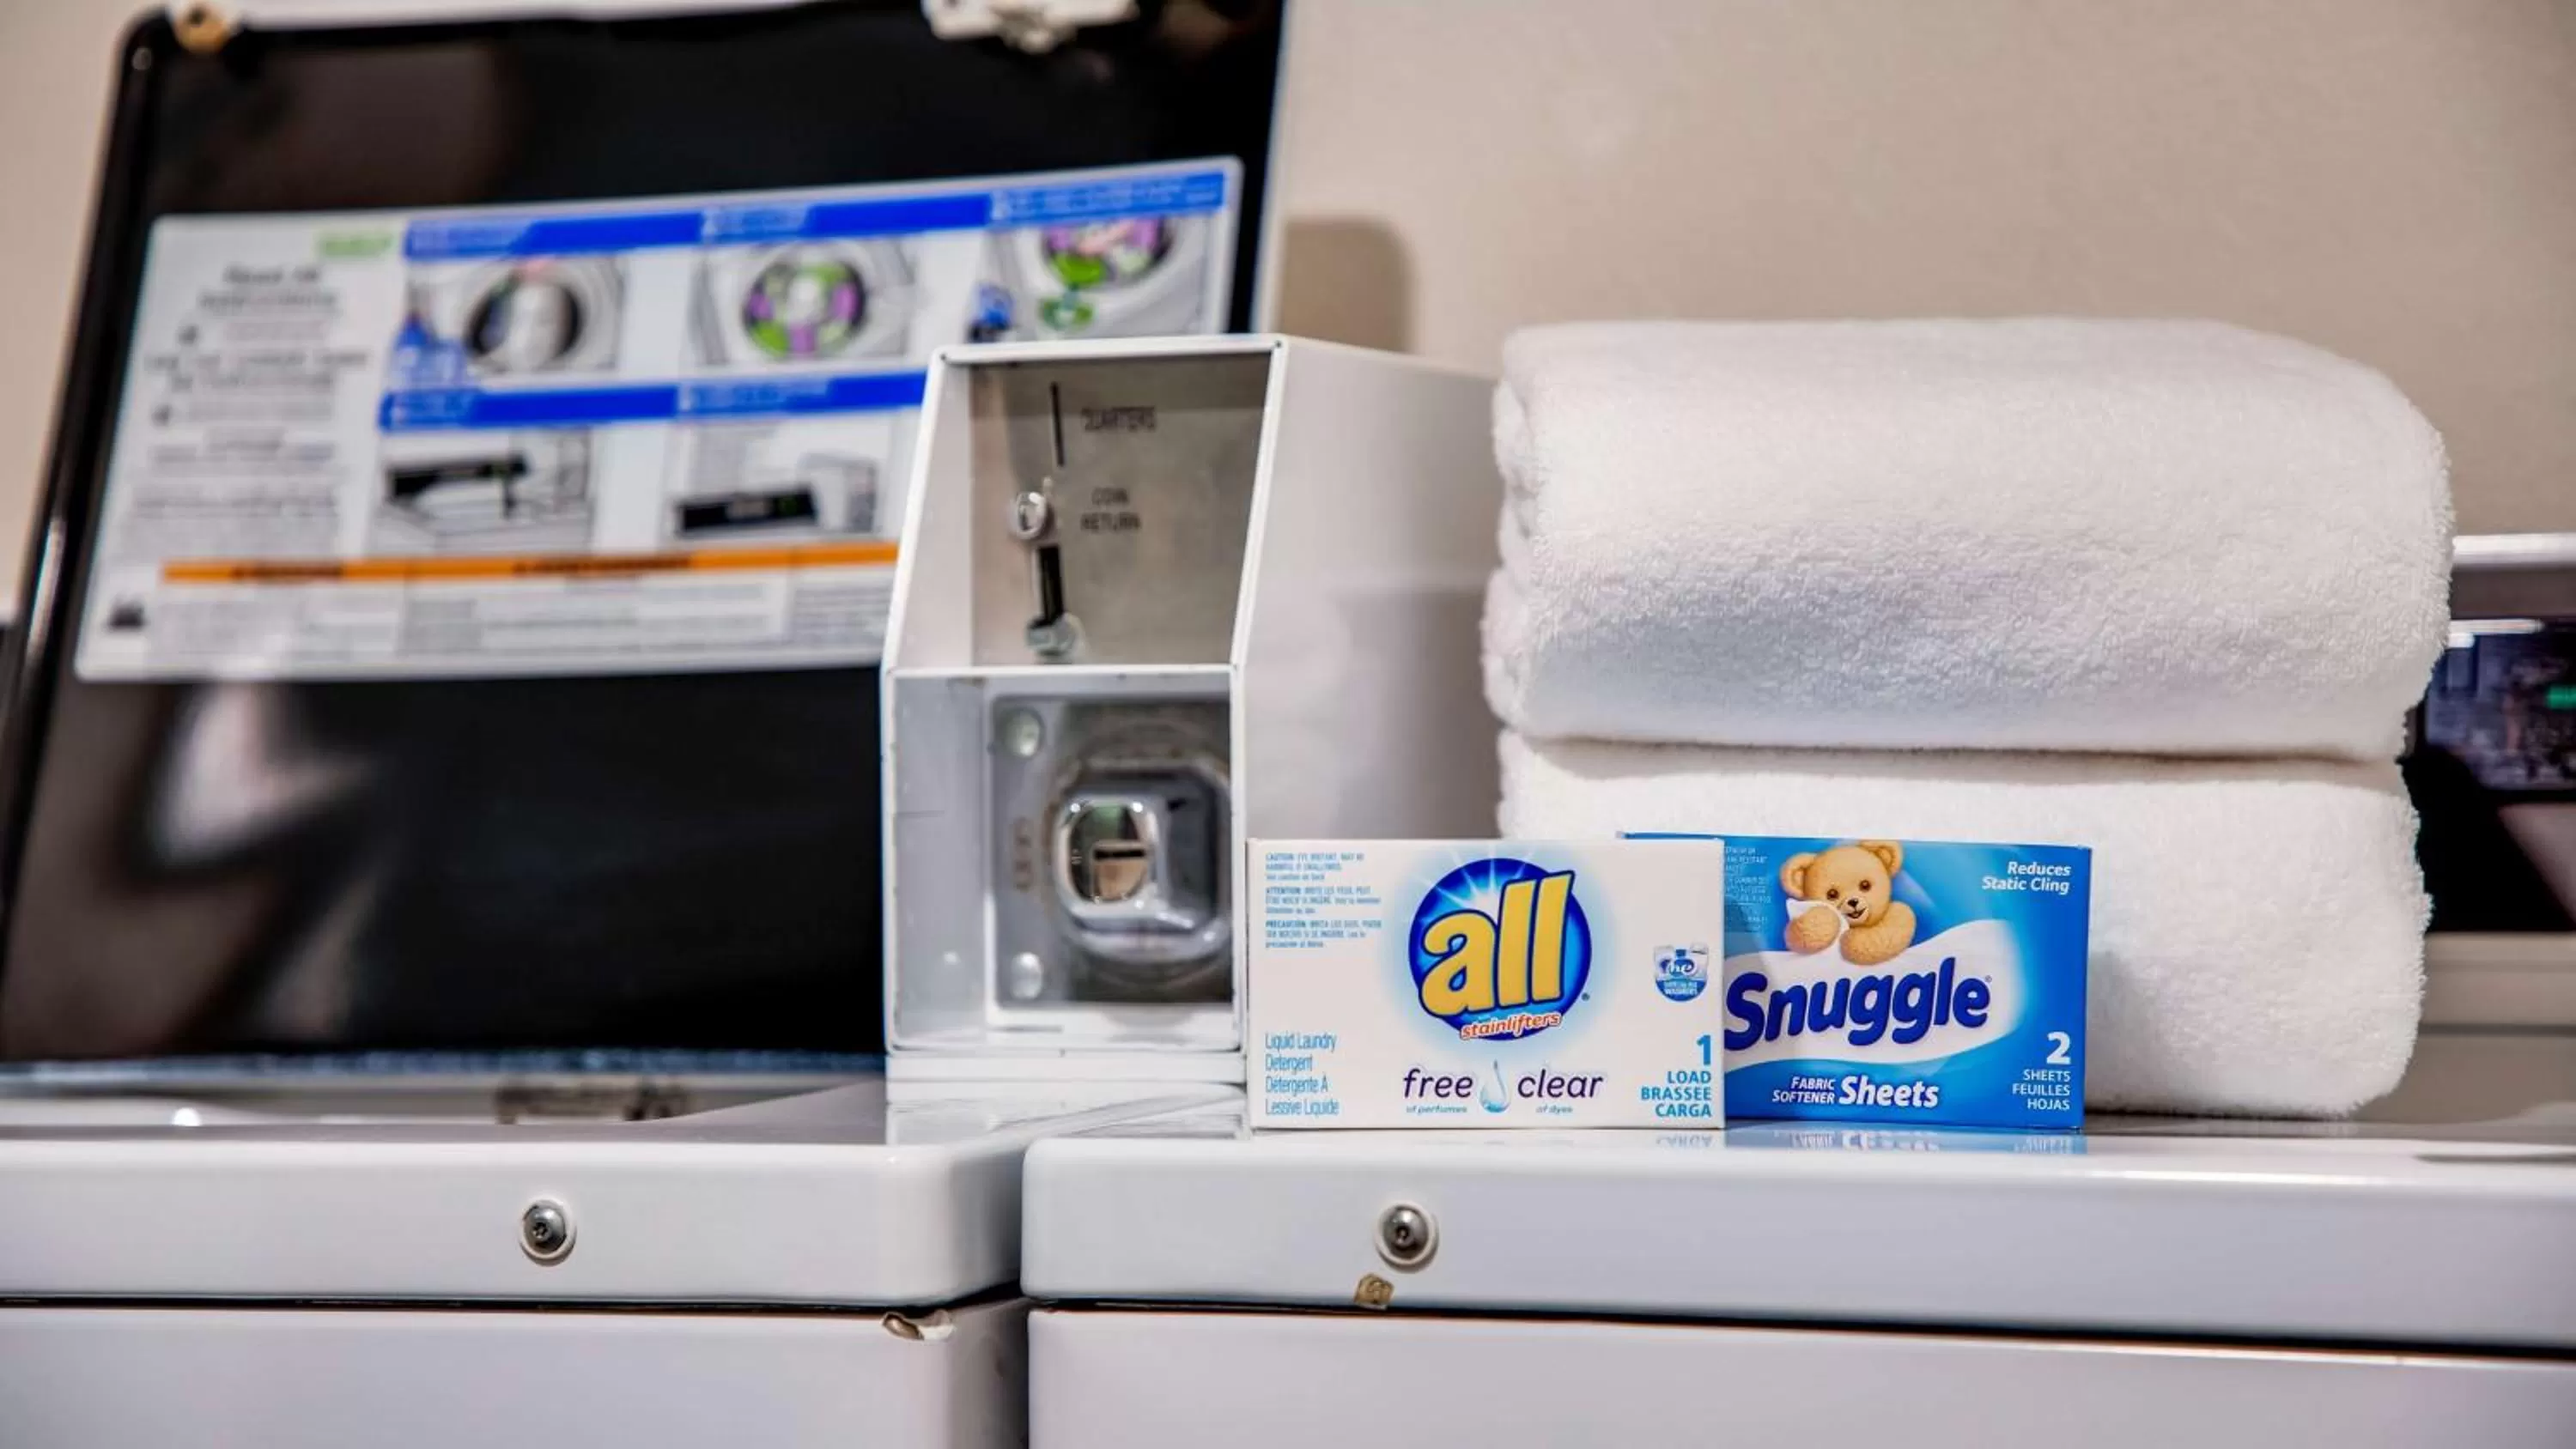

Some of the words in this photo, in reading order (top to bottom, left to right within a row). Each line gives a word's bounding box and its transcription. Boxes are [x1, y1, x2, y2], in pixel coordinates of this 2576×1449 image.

[2008, 861, 2072, 876] Reduces
[1982, 876, 2026, 890] Static
[2031, 876, 2070, 895] Cling
[1419, 870, 1575, 1019] all
[1724, 956, 1991, 1051] Snuggle
[1461, 1012, 1561, 1040] stainlifters
[1265, 1032, 1295, 1052] Liquid
[1297, 1032, 1337, 1053] Laundry
[1697, 1034, 1711, 1065] 1
[2046, 1031, 2071, 1064] 2
[1265, 1053, 1313, 1075] Detergent
[1403, 1068, 1473, 1098] free
[1516, 1068, 1603, 1098] clear
[1667, 1070, 1712, 1083] LOAD
[2022, 1069, 2071, 1082] SHEETS
[1641, 1086, 1712, 1100] BRASSEE
[1771, 1089, 1836, 1105] SOFTENER
[1790, 1076, 1836, 1091] FABRIC
[1838, 1075, 1939, 1108] Sheets
[2011, 1083, 2071, 1096] FEUILLES
[1265, 1098, 1303, 1115] Lessive
[1304, 1098, 1340, 1119] Liquide
[1418, 1103, 1467, 1114] perfumes
[1548, 1102, 1574, 1114] dyes
[1655, 1103, 1712, 1118] CARGA
[2027, 1098, 2071, 1111] HOJAS
